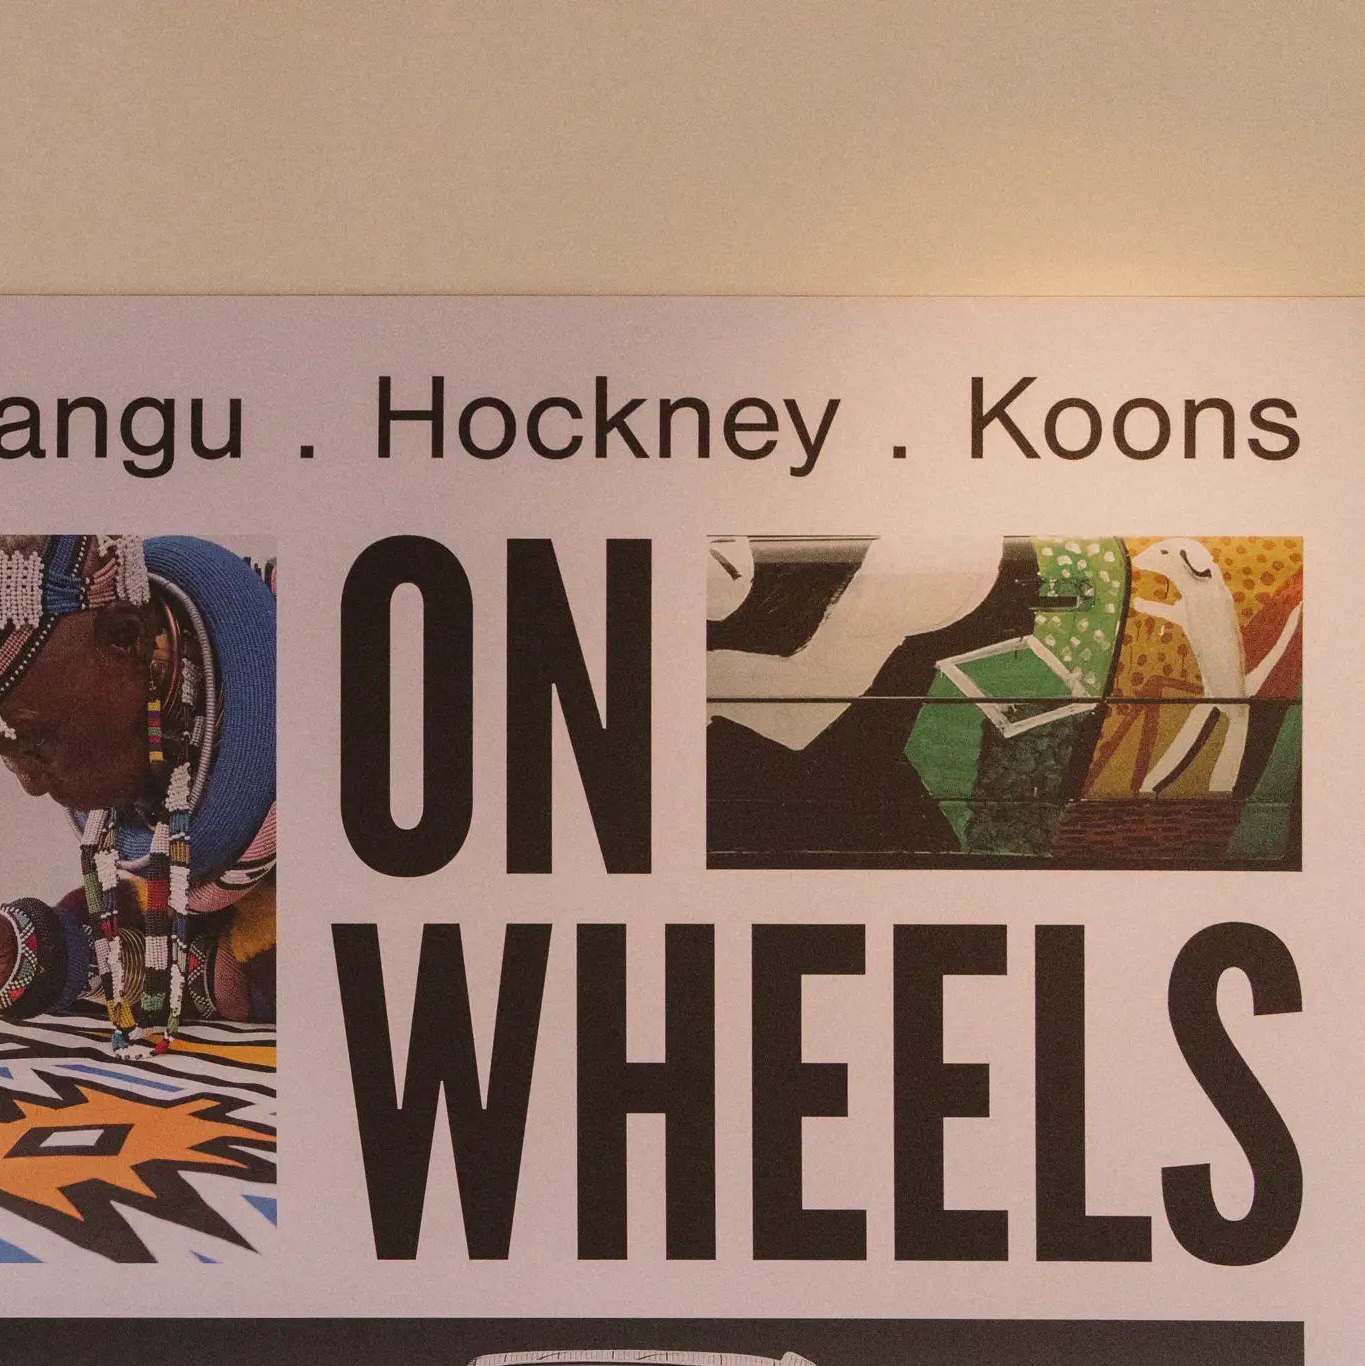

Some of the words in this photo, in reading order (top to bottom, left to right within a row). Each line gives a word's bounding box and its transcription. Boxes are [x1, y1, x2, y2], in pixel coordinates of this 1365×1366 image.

[378, 375, 841, 478] Hockney
[972, 376, 1300, 461] Koons
[340, 534, 652, 878] ON
[331, 921, 1303, 1267] WHEELS
